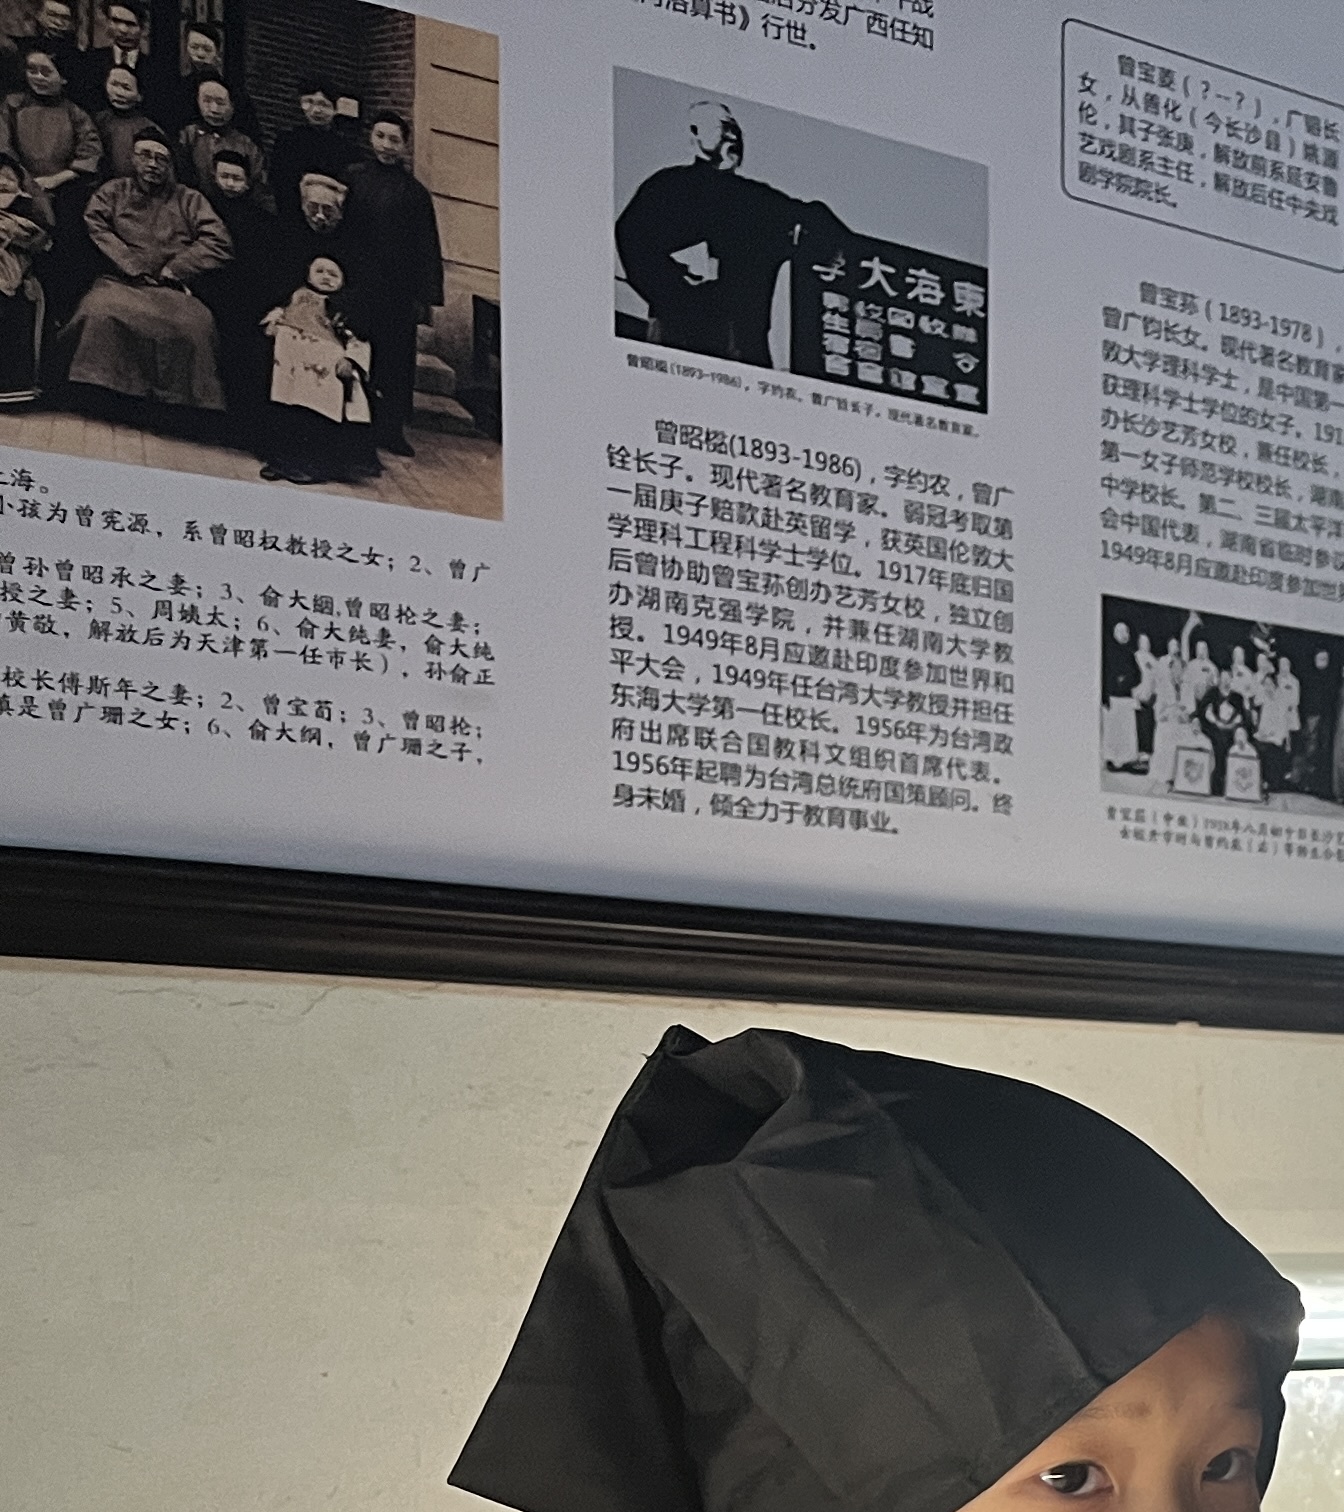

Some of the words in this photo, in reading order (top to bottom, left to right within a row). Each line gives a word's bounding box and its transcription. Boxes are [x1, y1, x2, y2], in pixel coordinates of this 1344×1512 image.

[0, 611, 495, 686] 黄敬，解放后为天津第一任市长），孙俞正
